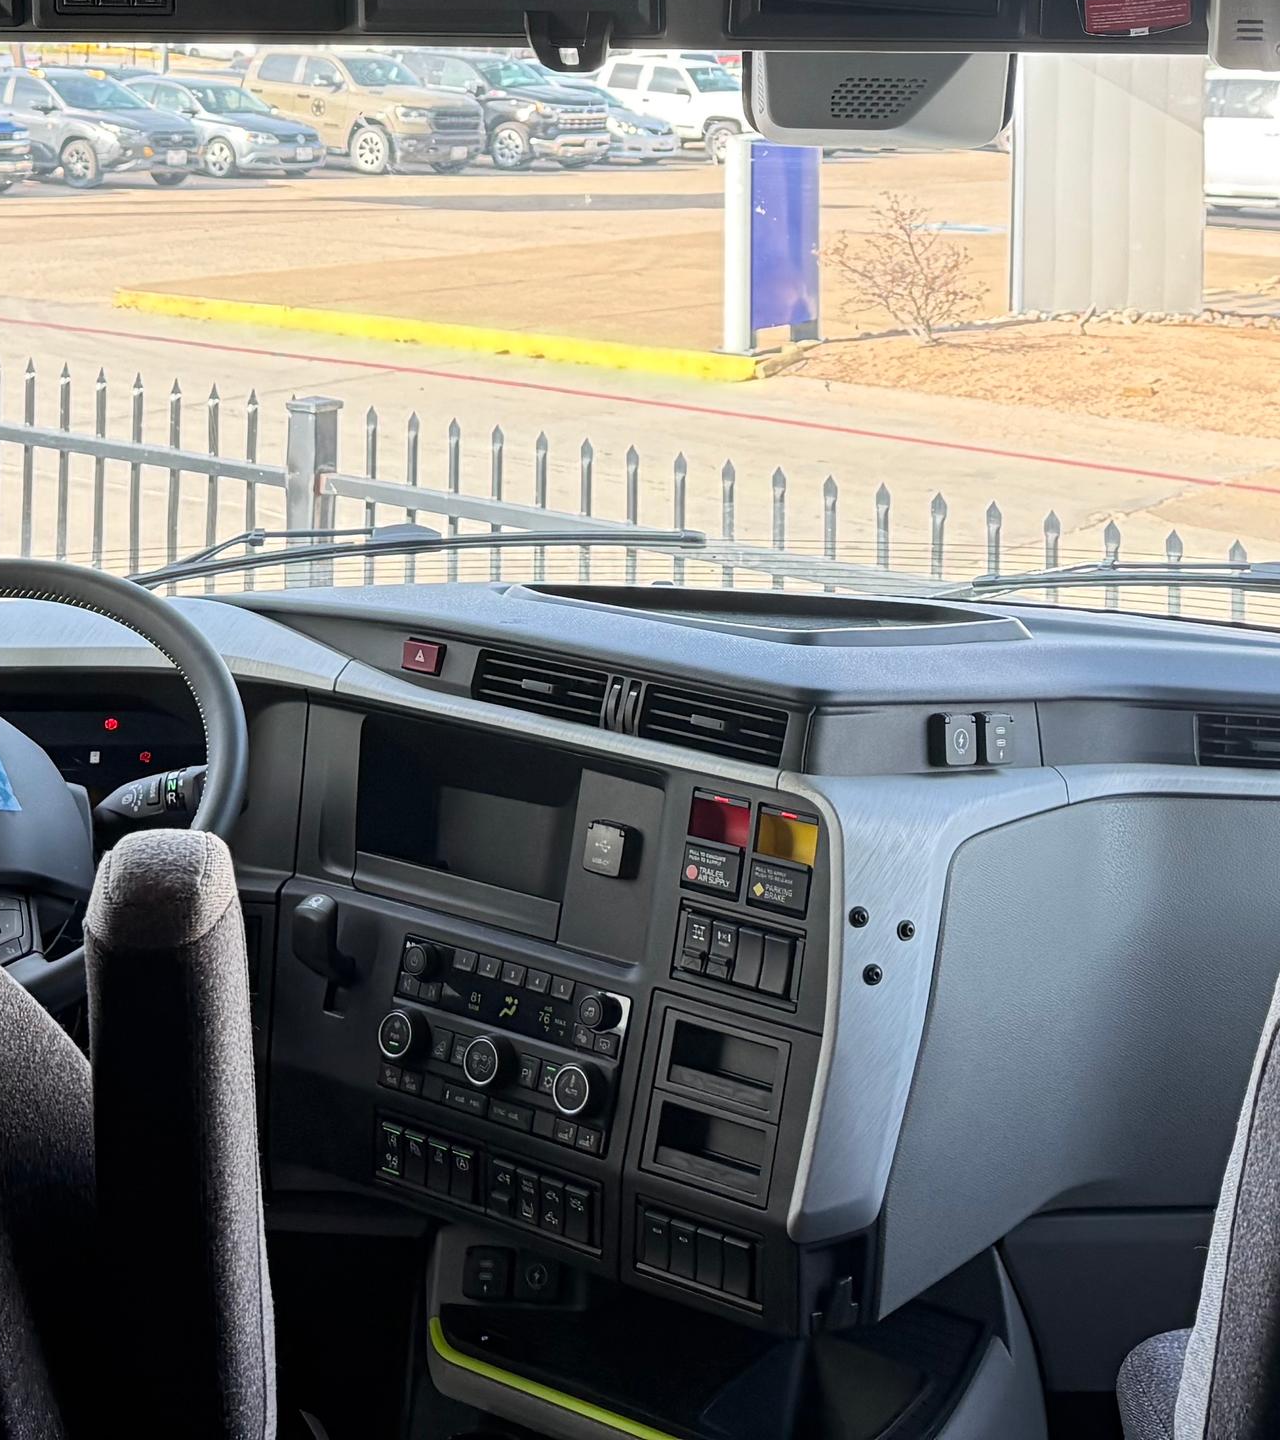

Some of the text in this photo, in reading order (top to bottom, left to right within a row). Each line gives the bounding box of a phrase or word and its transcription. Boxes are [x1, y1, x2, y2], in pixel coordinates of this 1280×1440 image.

[167, 778, 178, 791] N
[168, 791, 177, 804] R
[699, 866, 725, 879] TRAILER
[697, 873, 731, 888] AIR SUPPLY
[765, 883, 793, 898] PARKING
[764, 891, 786, 904] BRAKE
[538, 1010, 551, 1025] 76
